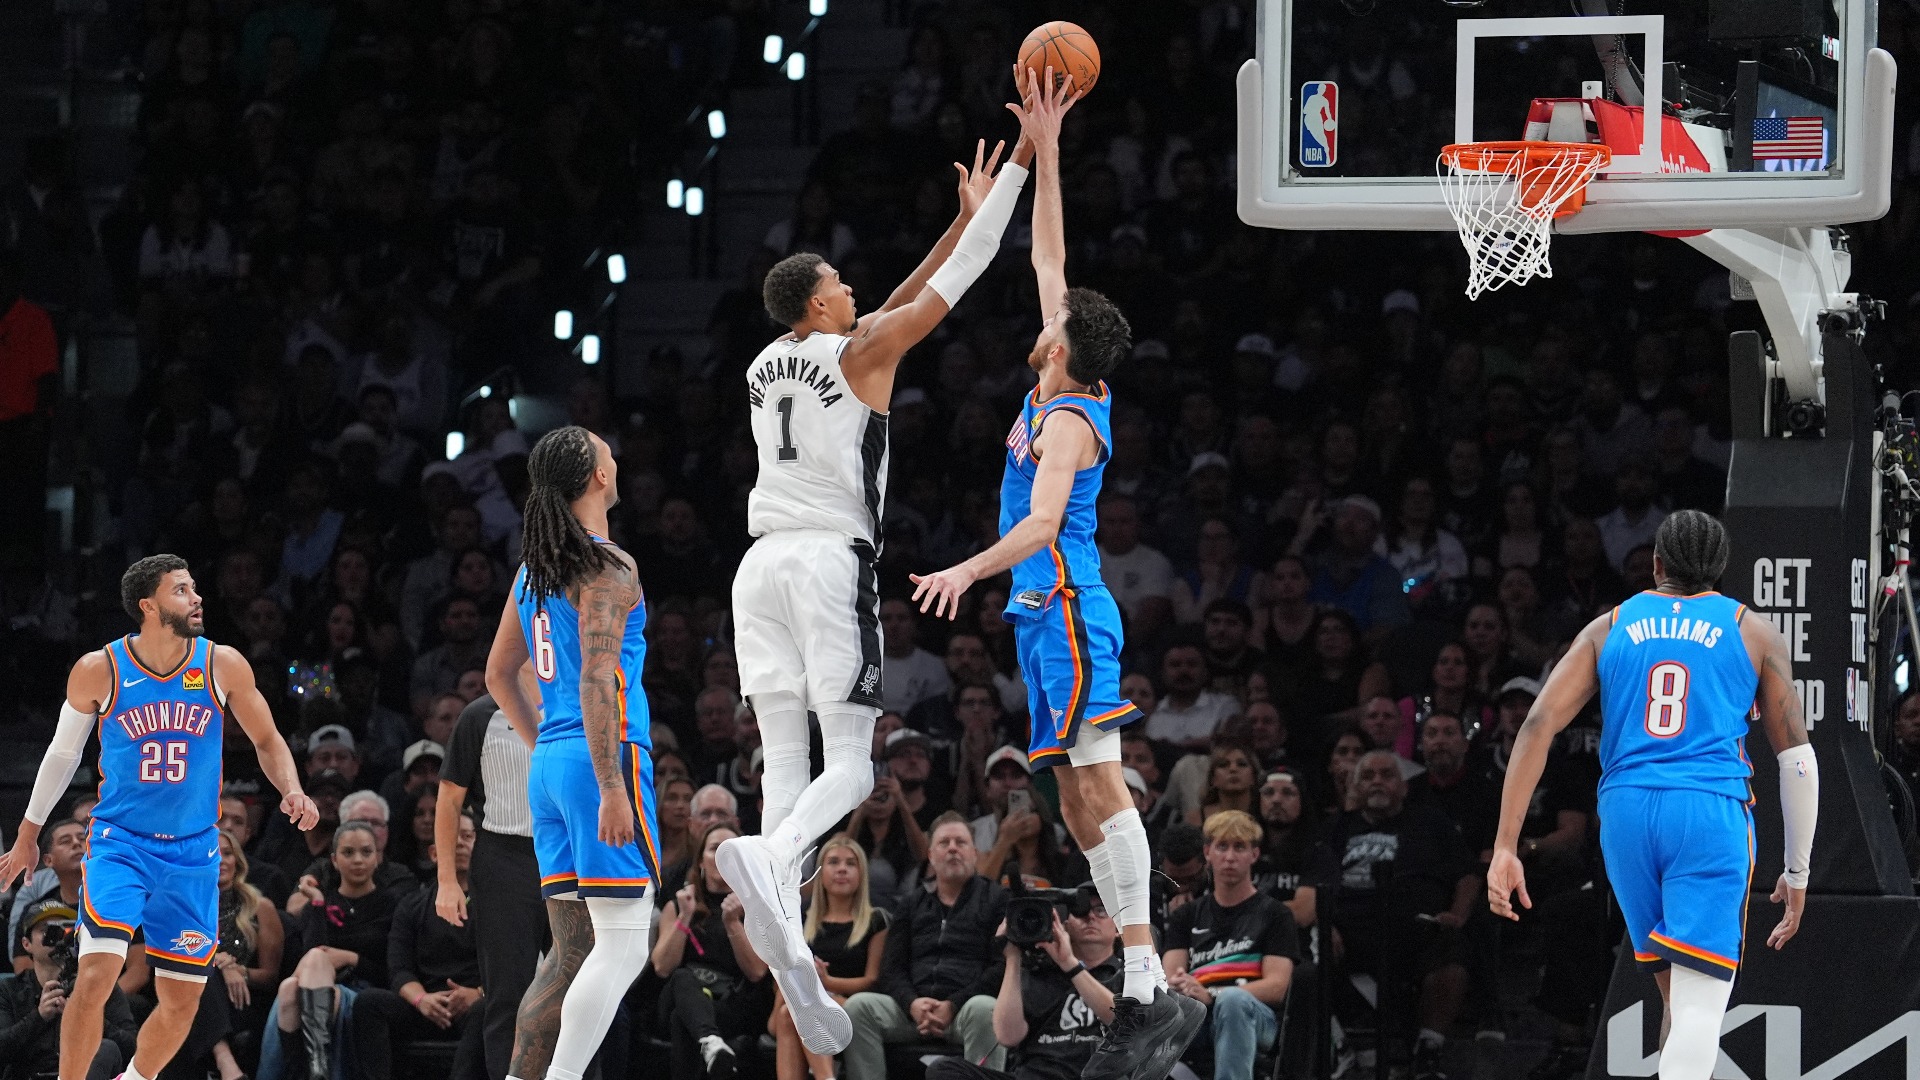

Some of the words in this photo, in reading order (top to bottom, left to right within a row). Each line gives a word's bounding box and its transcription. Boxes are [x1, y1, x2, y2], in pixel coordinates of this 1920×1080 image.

[1305, 148, 1322, 161] NBA
[750, 357, 843, 409] WEMBANYAMA
[776, 394, 799, 464] 1
[1753, 557, 1811, 608] GET
[1851, 558, 1867, 608] GET
[532, 608, 557, 683] 6
[1625, 617, 1723, 649] WILLIAMS
[1851, 613, 1867, 663] THE
[117, 700, 214, 740] THUNDER
[1644, 659, 1690, 739] 8
[139, 740, 188, 783] 25
[179, 936, 202, 946] OKC
